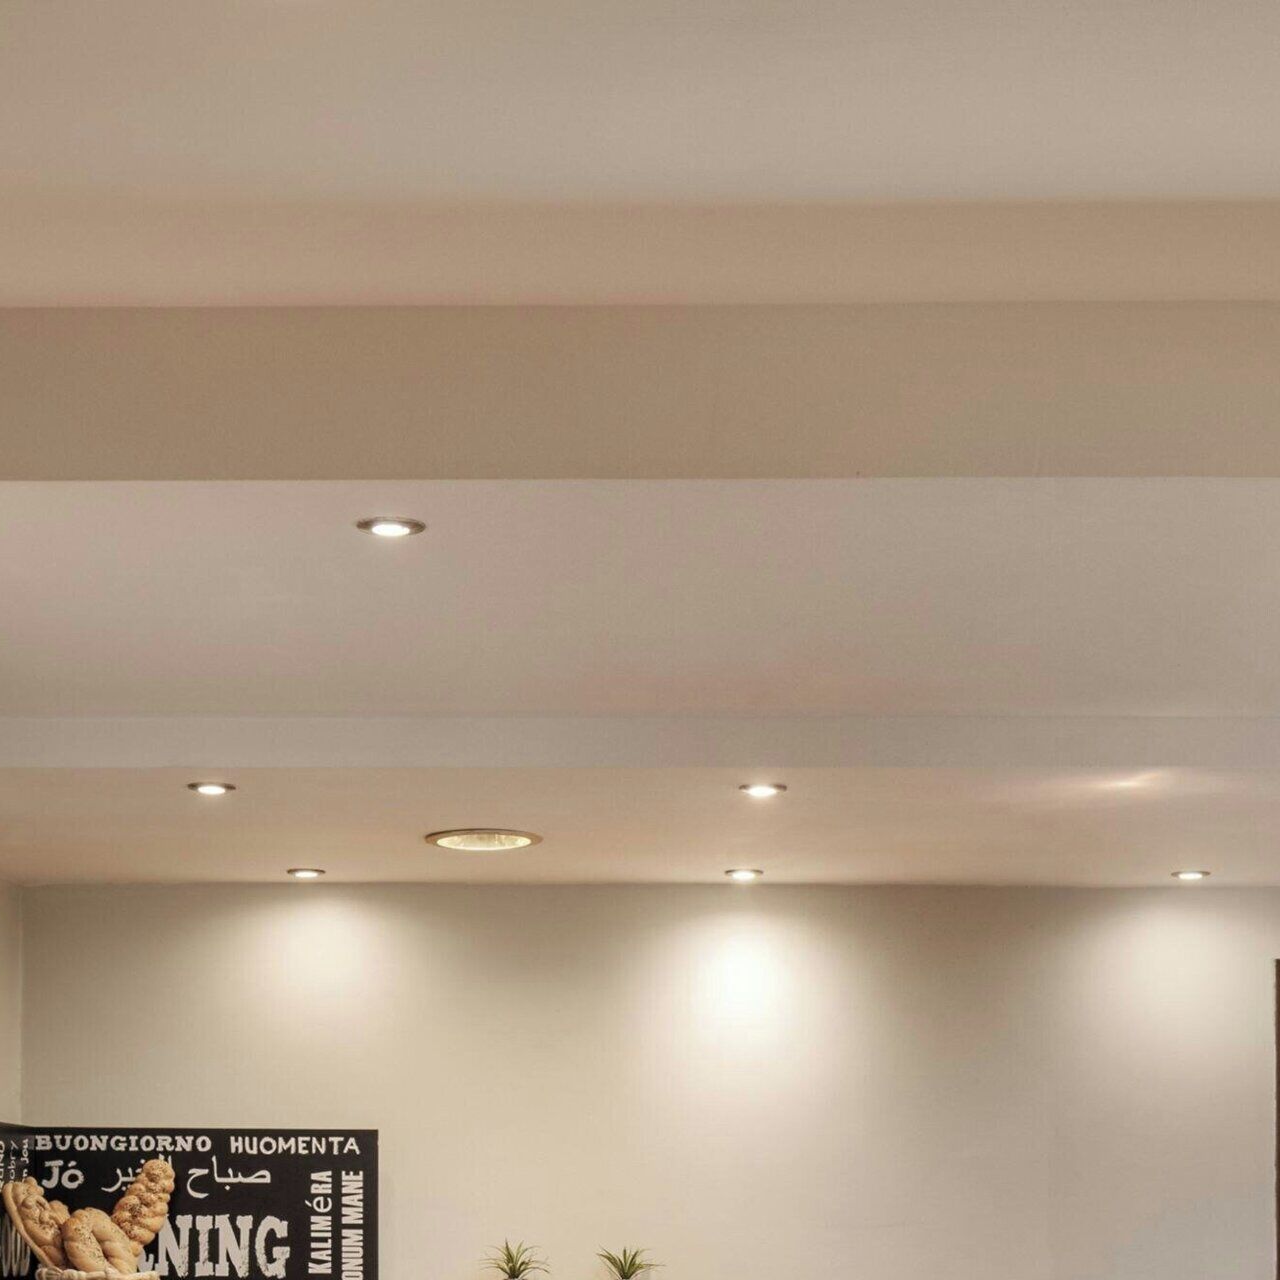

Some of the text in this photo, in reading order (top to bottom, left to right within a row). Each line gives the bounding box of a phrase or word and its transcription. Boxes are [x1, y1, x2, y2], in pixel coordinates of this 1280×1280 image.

[35, 1134, 212, 1152] BUONGIORNO
[230, 1136, 361, 1155] HUOMENTA
[187, 1154, 271, 1199] صباح
[341, 1170, 364, 1225] MANE
